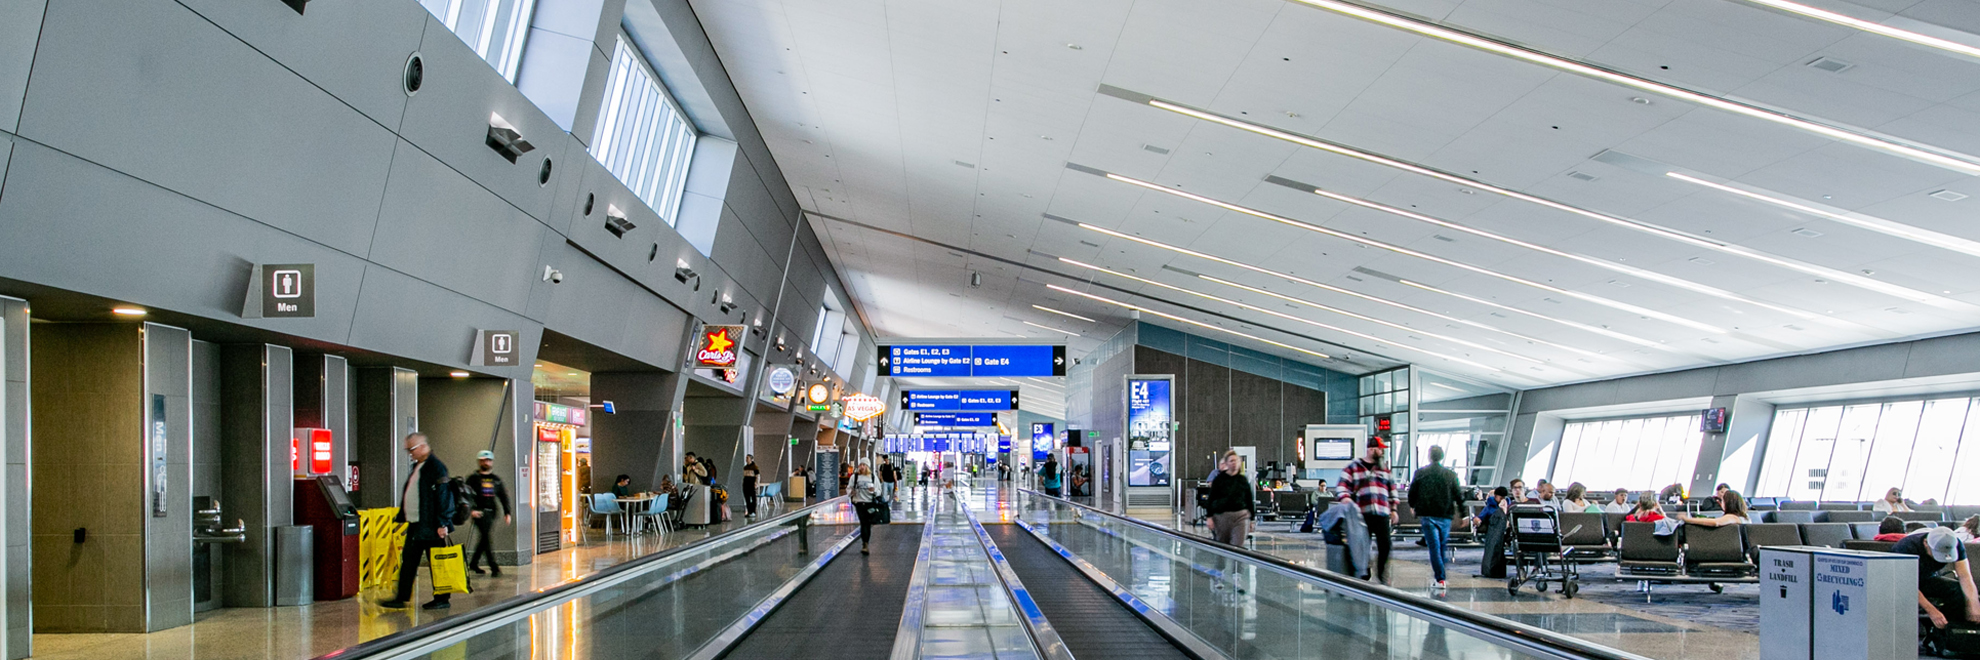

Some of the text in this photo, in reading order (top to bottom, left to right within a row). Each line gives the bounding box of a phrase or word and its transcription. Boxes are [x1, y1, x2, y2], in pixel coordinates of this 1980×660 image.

[277, 302, 298, 312] Men
[903, 348, 950, 356] Gates E1, E2, E3
[921, 357, 940, 366] Lounge
[941, 357, 948, 366] by
[1131, 382, 1148, 399] E4
[1033, 424, 1044, 434] E3
[155, 421, 164, 452] Men
[1773, 558, 1794, 568] TRASH
[1830, 564, 1851, 574] MIXED
[1769, 572, 1798, 583] LANDFILL
[1823, 575, 1858, 587] RECYCLING
